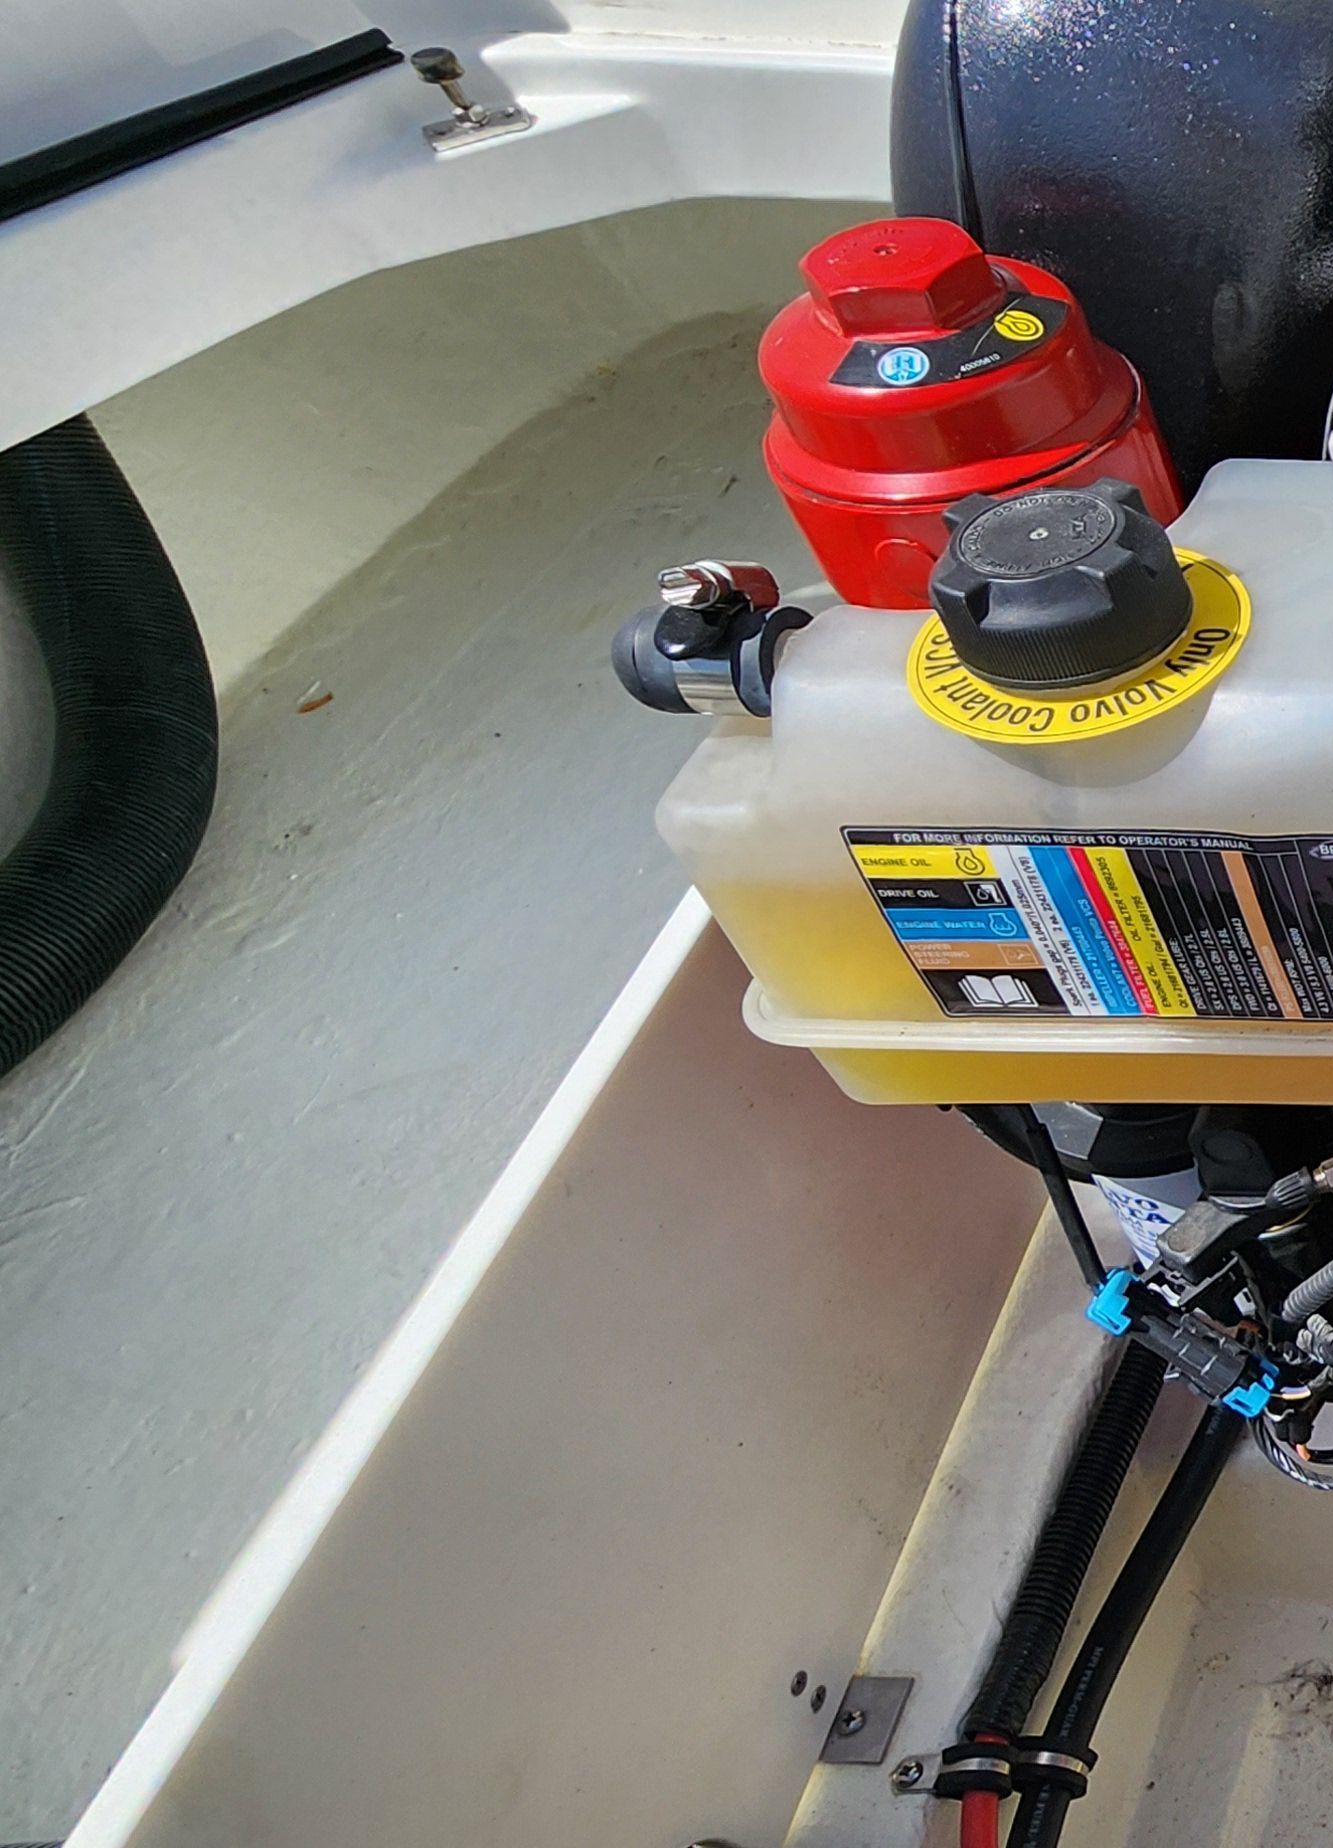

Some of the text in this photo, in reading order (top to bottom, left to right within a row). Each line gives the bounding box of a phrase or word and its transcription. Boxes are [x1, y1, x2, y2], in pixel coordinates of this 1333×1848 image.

[1164, 627, 1230, 677] Only
[934, 676, 1055, 732] Coolant
[1070, 679, 1178, 724] Volvo
[893, 833, 1253, 850] FOR MORE INFORMATION REFER TO OPERATOR'S MANUAL
[861, 857, 932, 867] ENGINE OIL
[877, 888, 940, 898] DRIVE OIL
[896, 920, 986, 930] ENGINE WATER
[909, 943, 953, 951] POWER
[914, 951, 971, 959] STEERING
[918, 958, 951, 966] FLUID
